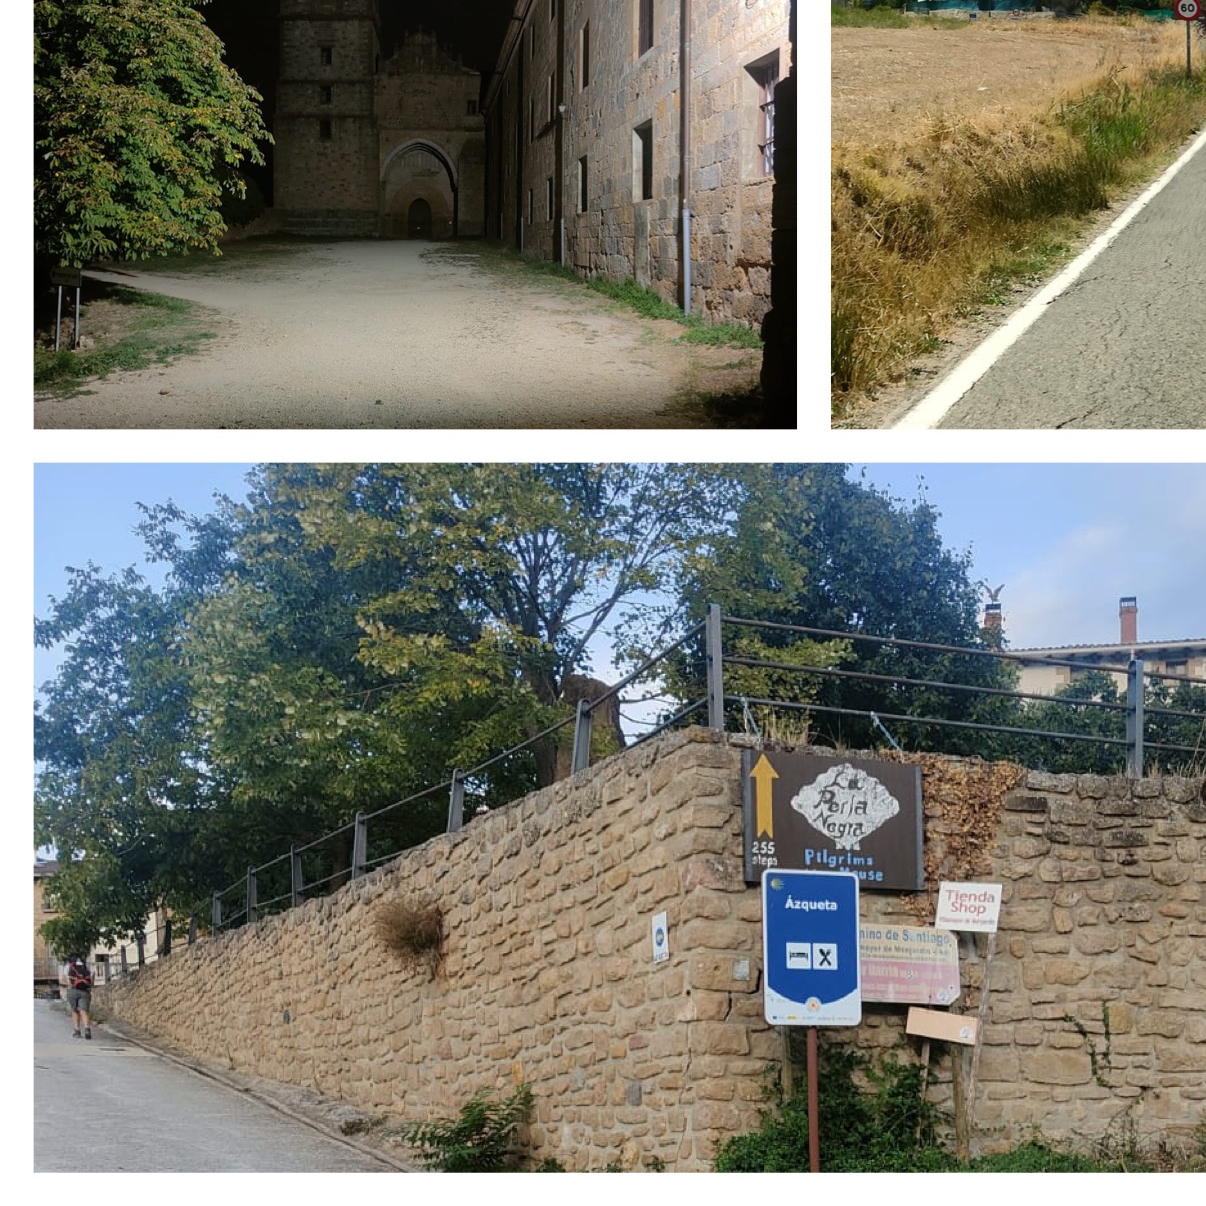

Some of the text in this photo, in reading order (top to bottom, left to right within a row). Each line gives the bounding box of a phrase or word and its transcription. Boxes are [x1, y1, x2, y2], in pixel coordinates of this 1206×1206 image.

[1181, 3, 1195, 12] 60
[813, 789, 868, 818] Perla
[812, 809, 867, 838] Negra
[752, 842, 775, 854] 255
[752, 856, 778, 869] steps
[804, 849, 873, 867] Pilgrims
[785, 895, 838, 912] Ázqueta
[945, 890, 995, 903] Tienda
[951, 901, 986, 916] Shop
[885, 929, 899, 941] de
[902, 930, 950, 947] Sntiago
